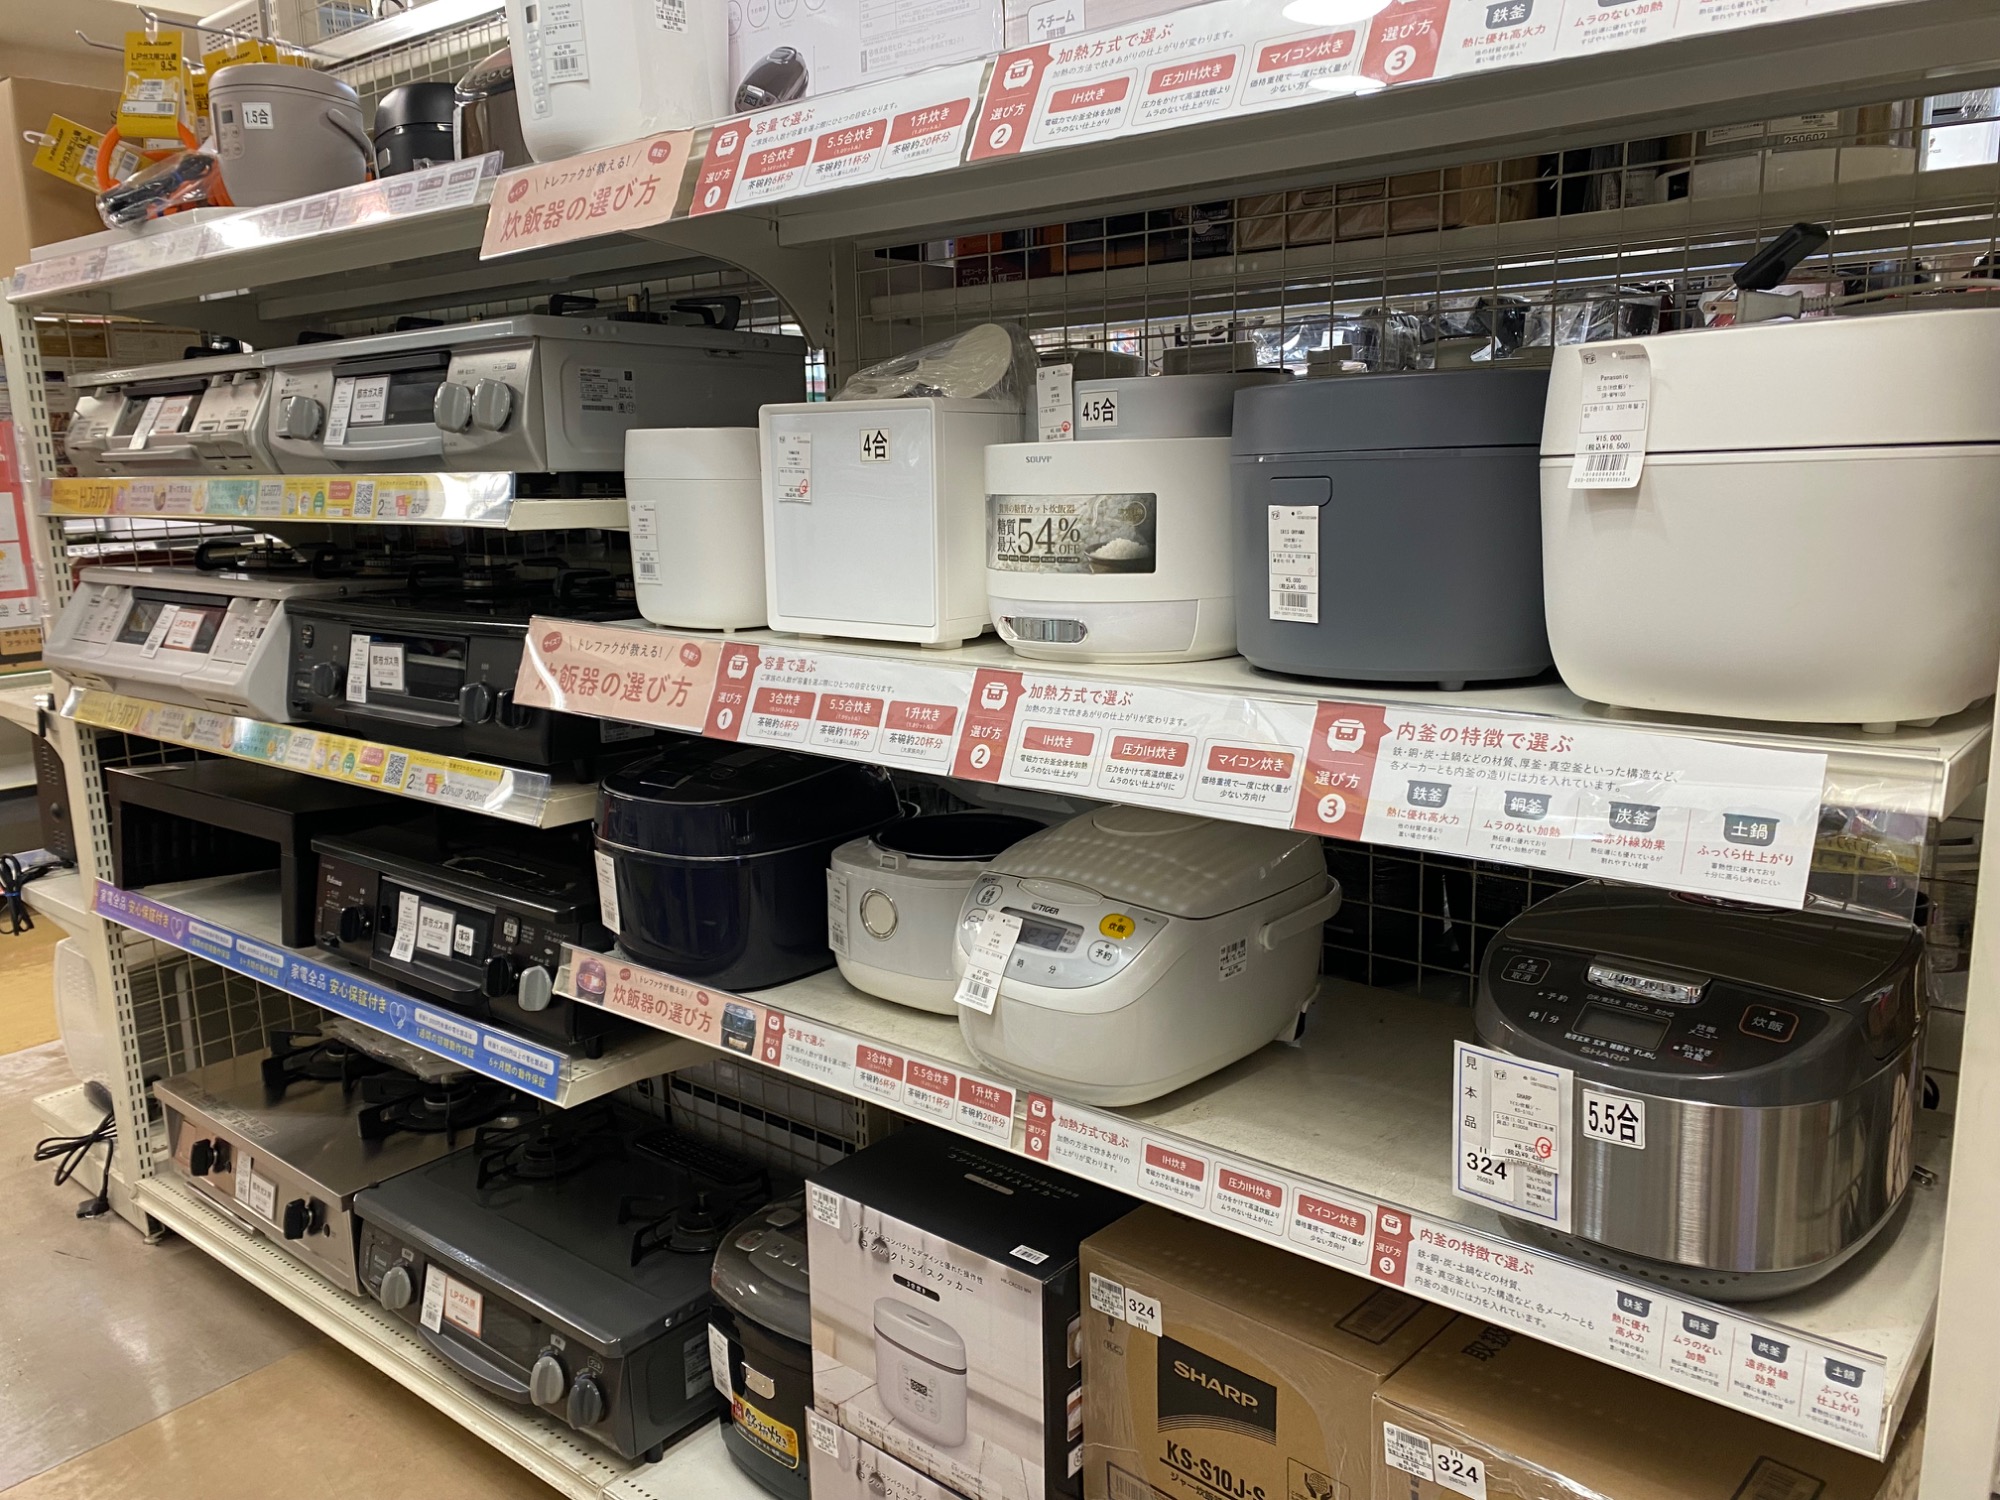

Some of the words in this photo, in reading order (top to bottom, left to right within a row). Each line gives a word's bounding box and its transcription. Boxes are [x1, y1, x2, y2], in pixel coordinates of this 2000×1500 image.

[1037, 12, 1075, 32] スチーム
[1493, 4, 1524, 24] 鉄釜
[1574, 2, 1663, 27] ムラのない加熱
[1381, 20, 1431, 43] 選び方
[1462, 24, 1546, 48] 熱に優れ高火力
[1057, 25, 1173, 65] 加熱方式で選ぶ
[1269, 39, 1344, 65] マイコン炊き
[1394, 50, 1406, 70] 3
[1158, 62, 1222, 89] 圧力IH炊き
[1071, 86, 1106, 104] IH炊き
[1141, 84, 1231, 110] 圧力をかけて高温炊飯より
[244, 109, 269, 125] 1.5合
[911, 107, 949, 126] 1升炊き
[989, 103, 1025, 121] 選び方
[1146, 98, 1219, 118] ムラのない仕上がりに
[755, 109, 814, 135] 容量で選ぶ
[1049, 117, 1110, 137] ムラのない仕上がり
[827, 127, 873, 150] 5.5合炊き
[892, 132, 951, 156] 茶碗約20杯分
[761, 147, 794, 165] 3合炊き
[816, 153, 871, 175] 茶碗約11杯分
[544, 155, 630, 190] トレファクが教える!
[705, 167, 731, 184] 選び方
[747, 172, 794, 191] 茶碗約6杯分
[501, 174, 660, 243] 炊飯器の選び方
[1083, 398, 1115, 422] 4.5合
[863, 430, 888, 459] 4合
[1585, 443, 1630, 451] (税込¥16,500)
[998, 537, 1016, 553] 最大
[1018, 517, 1081, 555] 54%
[1059, 544, 1081, 554] OFF
[577, 637, 663, 659] トレファクが教える!
[764, 654, 817, 673] 容量で選ぶ
[718, 692, 742, 705] 選び方
[769, 691, 801, 706] 3合炊き
[1028, 683, 1134, 707] 加熱方式で選ぶ
[829, 699, 872, 715] 5.5合炊き
[905, 705, 940, 722] 1升炊き
[1025, 704, 1188, 727] 加熱の方法で炊きあがりの仕上がりが変わります。
[757, 717, 799, 731] 茶碗約6杯分
[819, 724, 870, 740] 茶碗約11杯分
[970, 724, 1002, 740] 選び方
[889, 732, 943, 749] 茶碗約20杯分
[1043, 734, 1073, 749] IH炊き
[1395, 721, 1575, 754] 内釜の特徴で選ぶ
[973, 747, 985, 765] 2
[1020, 752, 1088, 771] 電磁力でお釜全体を加熱
[1121, 742, 1178, 761] 圧力IH炊き
[1217, 751, 1285, 772] マイコン炊き
[1024, 764, 1078, 780] ムラのない仕上がり
[1104, 764, 1185, 783] 圧力をかけて高温炊飯より
[1313, 769, 1360, 789] 選び方
[1389, 759, 1623, 793] 各メーカーとも内釜の造りには力を入れています。
[1109, 775, 1175, 792] ムラのない仕上がりに
[1201, 775, 1292, 794] 価格重視で一度に炊く量が
[1219, 788, 1266, 803] 少ない方向け
[1411, 786, 1442, 804] 鉄釜
[1508, 795, 1543, 815] 銅釜
[1323, 798, 1337, 819] 3
[1386, 805, 1460, 826] 熱に優れ高火力
[1615, 807, 1650, 827] 炭釜
[1482, 819, 1561, 838] ムラのない加熱
[1731, 821, 1769, 841] 土鍋
[1489, 842, 1547, 856] すばやい加熱が可能
[1491, 833, 1547, 848] 熱伝導に優れており
[1600, 856, 1649, 870] 割れやすい材質
[1697, 844, 1794, 866] ふっくら仕上がり
[1039, 904, 1059, 915] TIGER
[1108, 922, 1126, 933] 炊飯
[1095, 949, 1113, 961] 予約
[1048, 966, 1056, 974] 分
[1517, 962, 1539, 971] 保温
[1511, 972, 1532, 982] 取消
[291, 964, 326, 991] 家電全品
[329, 978, 387, 1014] 安心保証付き
[1546, 992, 1569, 1003] 予約
[612, 983, 713, 1034] 炊飯器の選び方
[1528, 1011, 1539, 1020] 時
[1549, 1015, 1560, 1024] 分
[1751, 1016, 1785, 1033] 炊飯
[788, 1029, 825, 1048] 容量で選ぶ
[866, 1051, 894, 1068] 3合炊き
[1579, 1046, 1630, 1062] SHARP
[860, 1071, 896, 1089] 茶碗約6杯分
[913, 1066, 949, 1086] 5.5合炊き
[907, 1088, 950, 1109] 茶碗約11杯分
[970, 1084, 1001, 1102] 1升炊き
[961, 1104, 1006, 1128] 茶碗約20杯分
[1588, 1100, 1639, 1143] 5.5合
[1027, 1124, 1046, 1137] 選び方
[1058, 1115, 1129, 1149] 加熱方式で選ぶ
[1054, 1145, 1119, 1173] 仕上がりが変わります。
[1056, 1133, 1130, 1165] 加熱の方法で炊きあがりの
[1161, 1154, 1188, 1171] IH炊き
[1466, 1152, 1508, 1180] 324
[1148, 1179, 1194, 1199] ムラのない仕上がり
[1228, 1175, 1273, 1200] 圧力IH炊き
[1216, 1193, 1281, 1220] 圧力をかけて高温炊飯より
[1220, 1204, 1274, 1227] ムラのない仕上がりに
[1305, 1202, 1358, 1228] マイコン炊き
[1294, 1218, 1365, 1248] 価格重視で一度に炊く量が
[1309, 1234, 1346, 1252] 少ない方向け
[1375, 1242, 1402, 1257] 選び方
[1420, 1228, 1536, 1276] 内釜の特徴で選ぶ
[860, 1237, 974, 1294] コンパクトライスクッカー
[1417, 1248, 1523, 1292] 鉄・銅・炭・土鍋などの材質、
[1413, 1275, 1547, 1329] 内釜の造りには力を入れています。
[1415, 1263, 1596, 1331] 厚釜・真空釜といった構造など、各メーカーとも
[1623, 1297, 1643, 1313] 鉄釜
[1129, 1298, 1155, 1319] 324
[1612, 1313, 1650, 1333] 熱に優れ
[1615, 1326, 1644, 1343] 高火力
[1673, 1335, 1722, 1356] ムラのない
[1758, 1341, 1780, 1358] 炭釜
[1685, 1350, 1707, 1364] 加熱
[1745, 1357, 1789, 1381] 遠赤外線
[1832, 1364, 1856, 1382] 土鍋
[1173, 1359, 1258, 1408] SHARP
[1754, 1374, 1776, 1389] 効果
[1821, 1384, 1860, 1404] ふっくら
[1817, 1395, 1861, 1417] 仕上がり
[1438, 1455, 1479, 1483] 324
